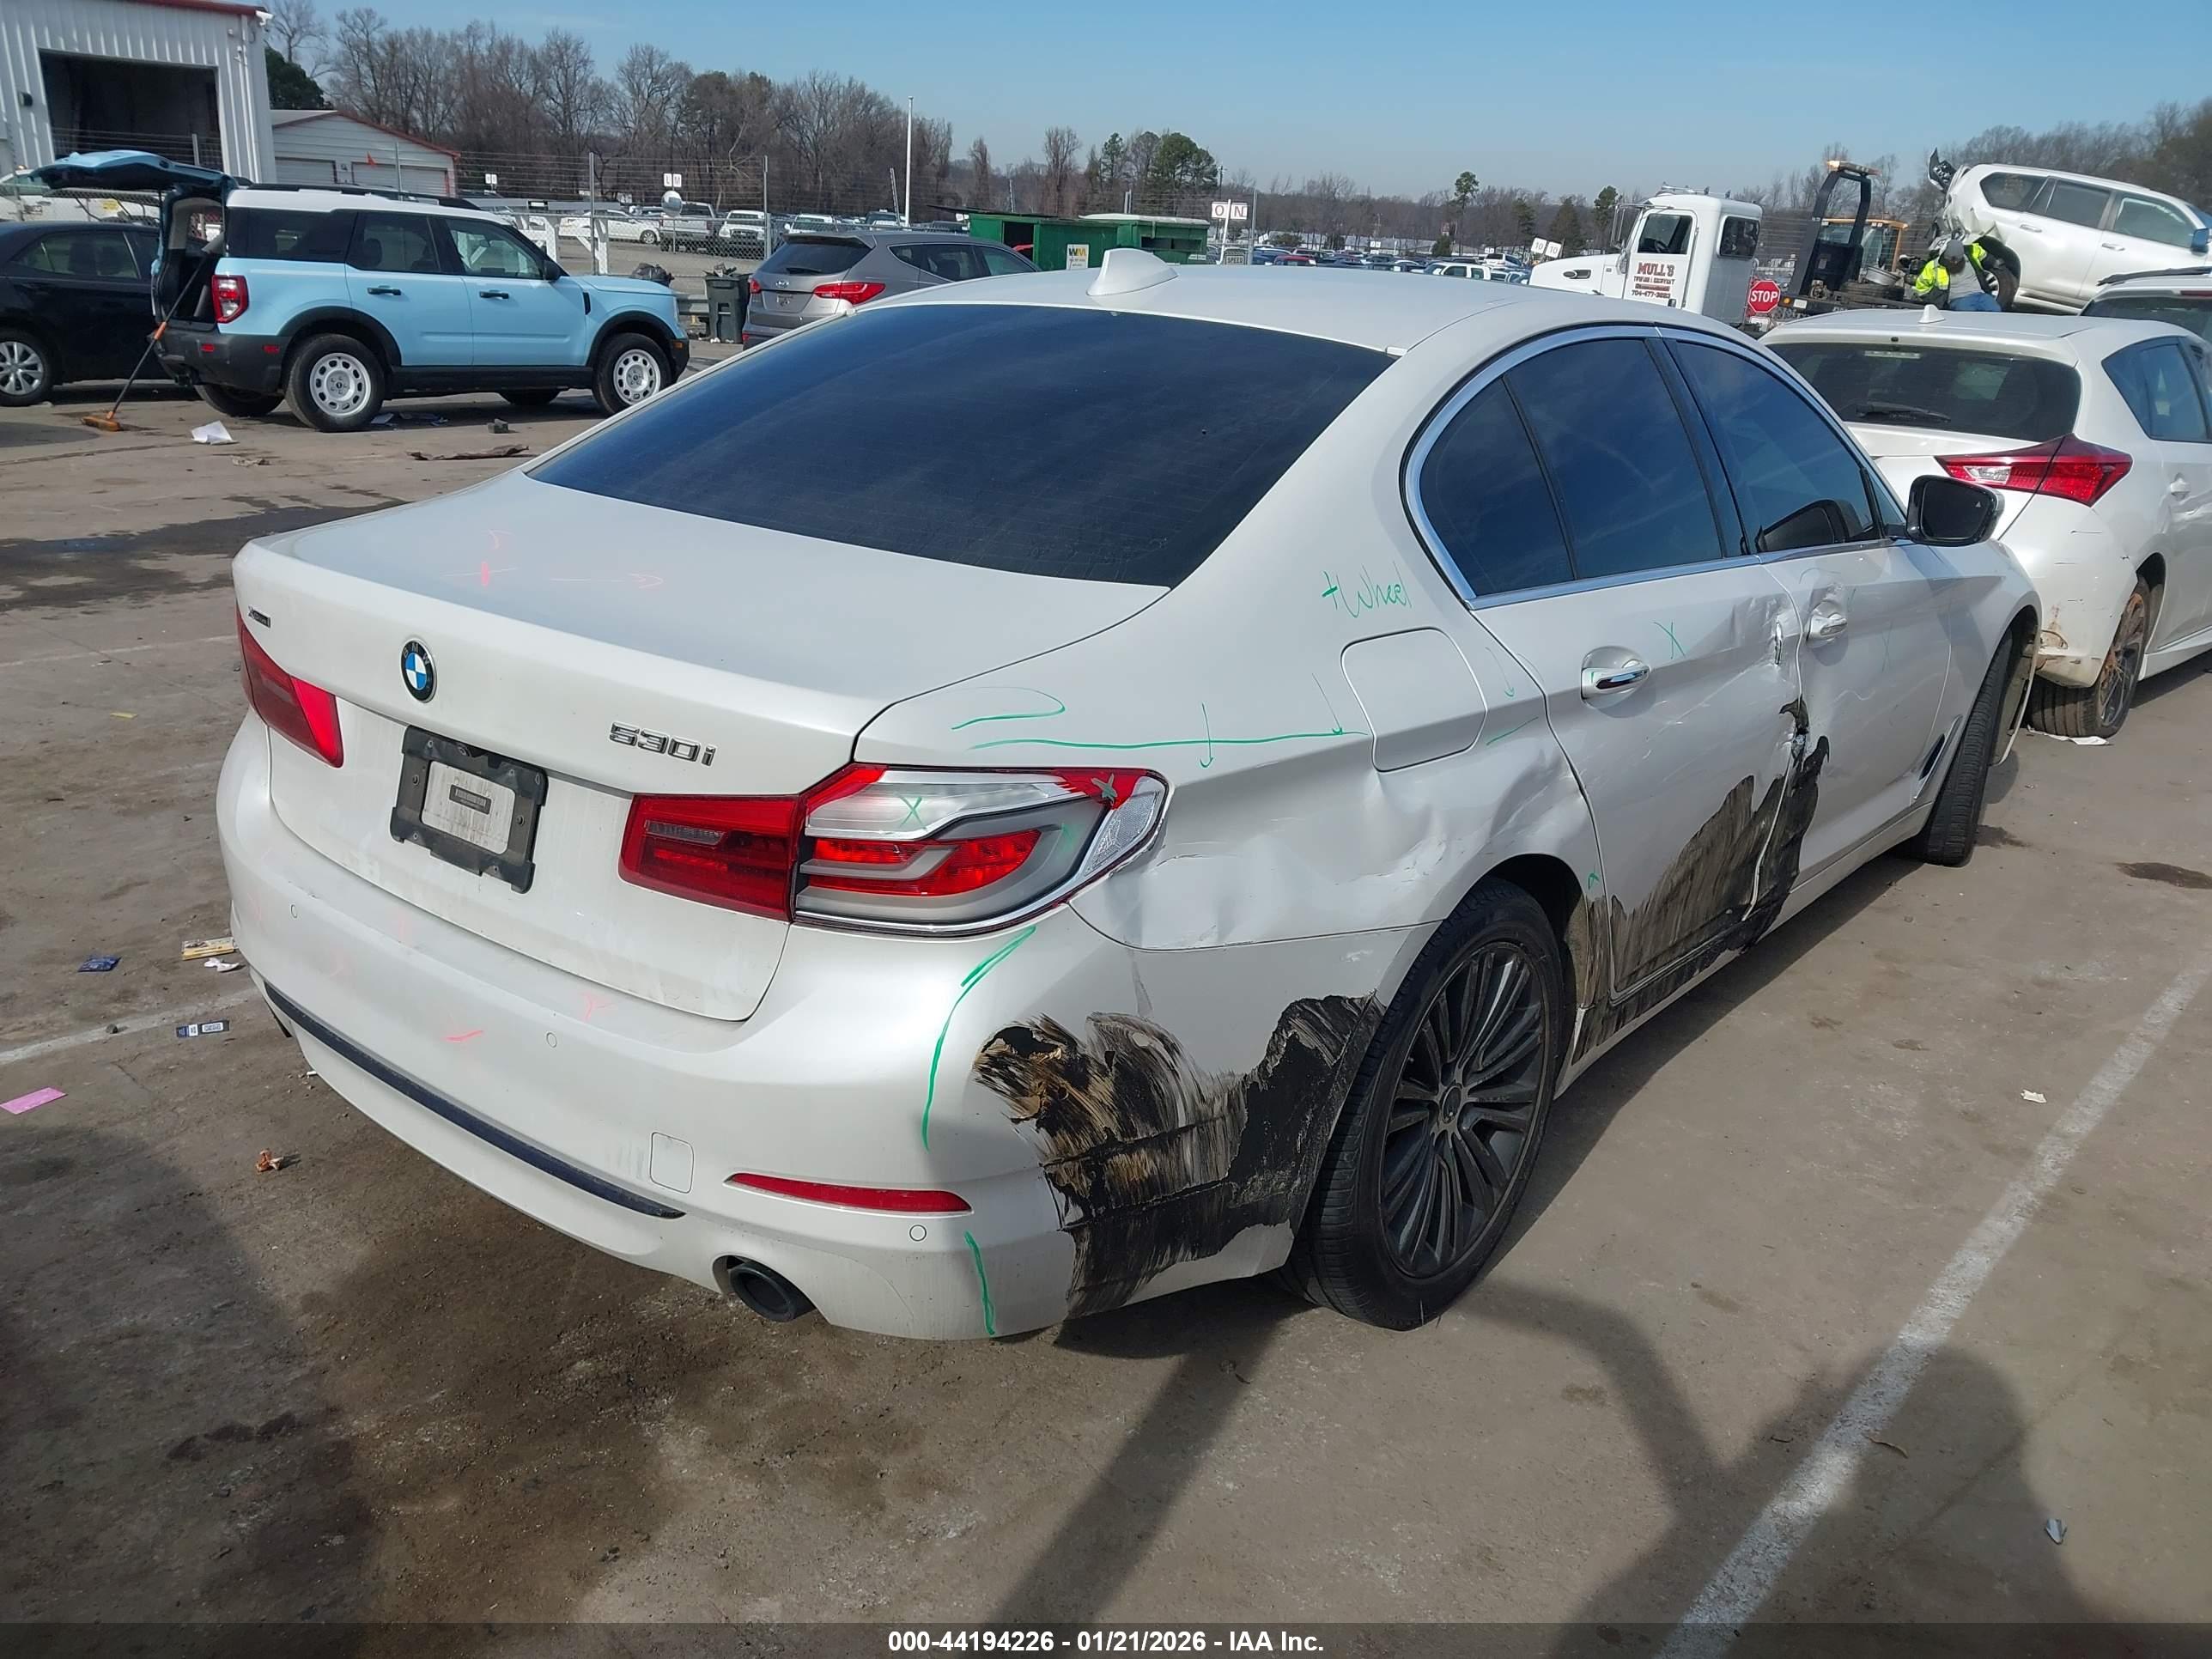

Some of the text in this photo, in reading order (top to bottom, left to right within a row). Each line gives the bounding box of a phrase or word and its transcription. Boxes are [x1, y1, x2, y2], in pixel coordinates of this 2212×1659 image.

[1226, 257, 1243, 265] SPEED
[1750, 289, 1778, 303] STOP
[609, 720, 717, 768] 530i
